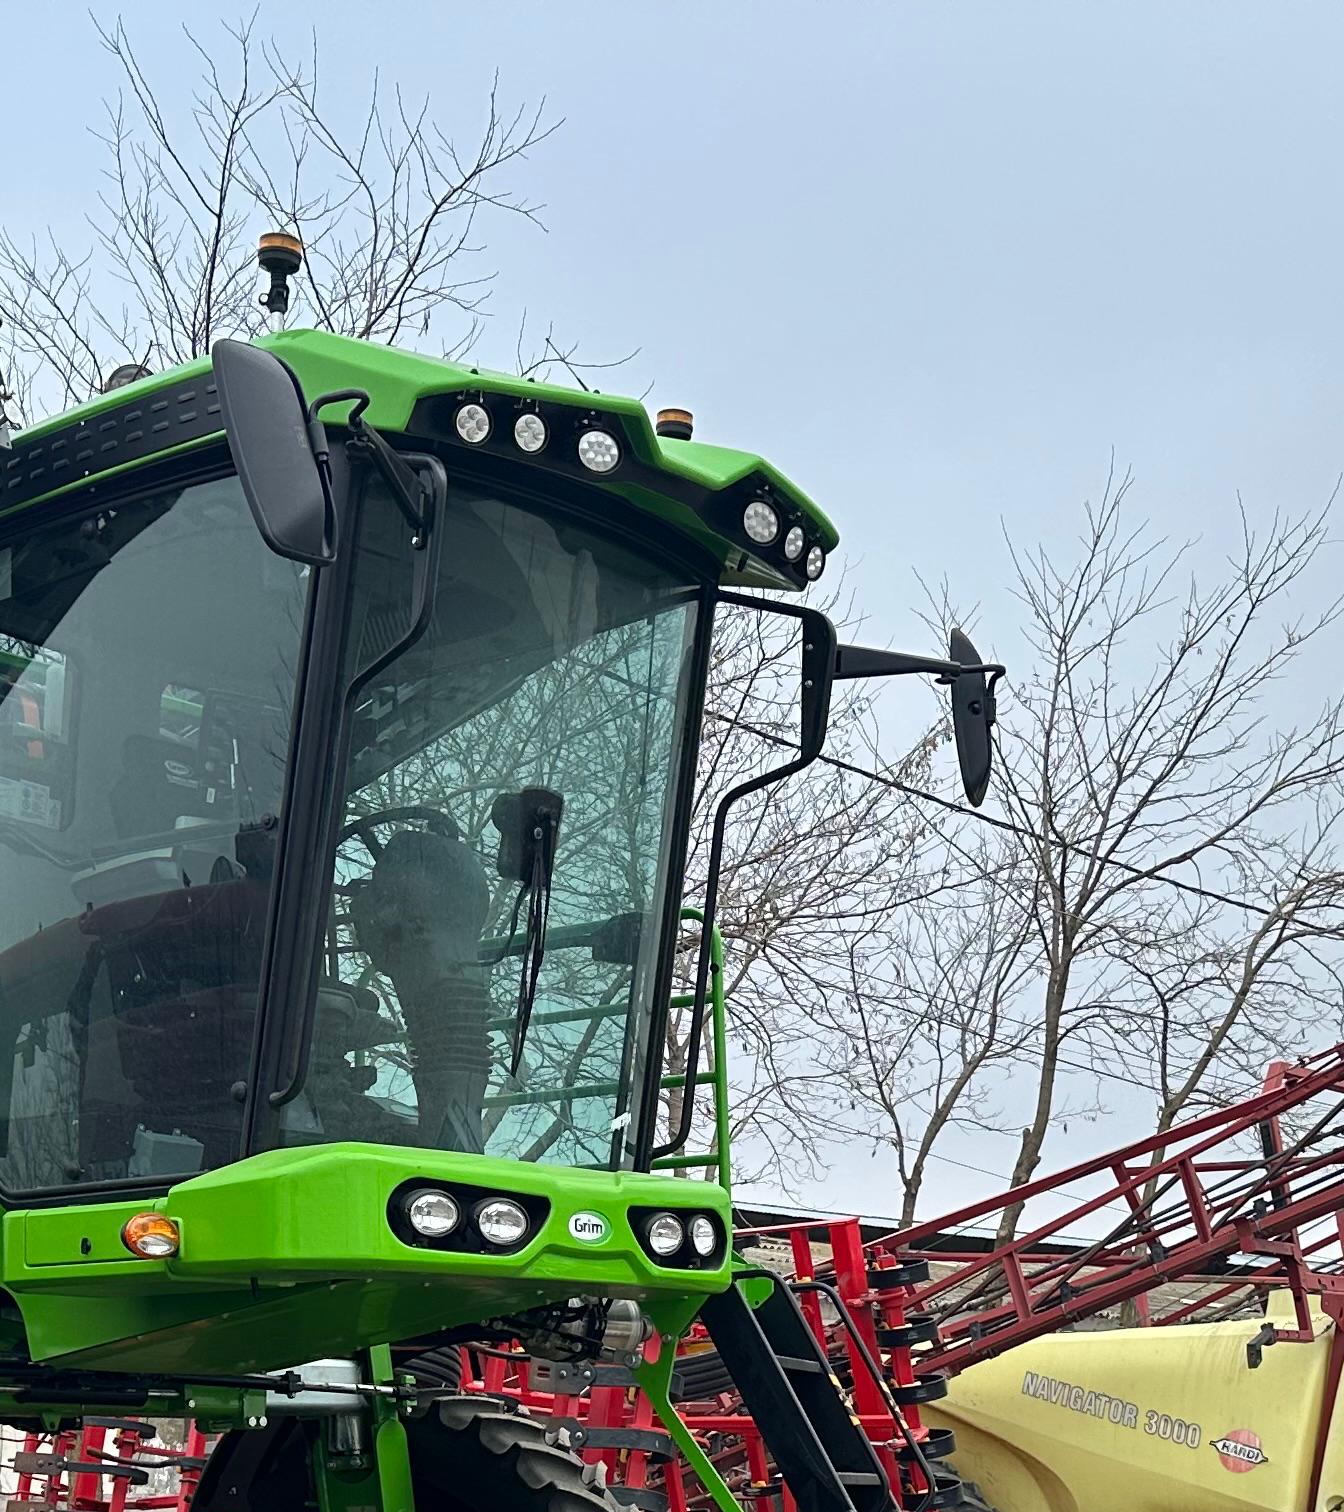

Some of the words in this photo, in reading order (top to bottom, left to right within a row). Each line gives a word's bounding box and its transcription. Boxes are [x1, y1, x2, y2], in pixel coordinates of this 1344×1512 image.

[574, 1217, 603, 1234] Grim
[1022, 1371, 1138, 1430] NAVIGATOR
[1144, 1408, 1201, 1449] 3000
[1221, 1441, 1260, 1461] HARDI
